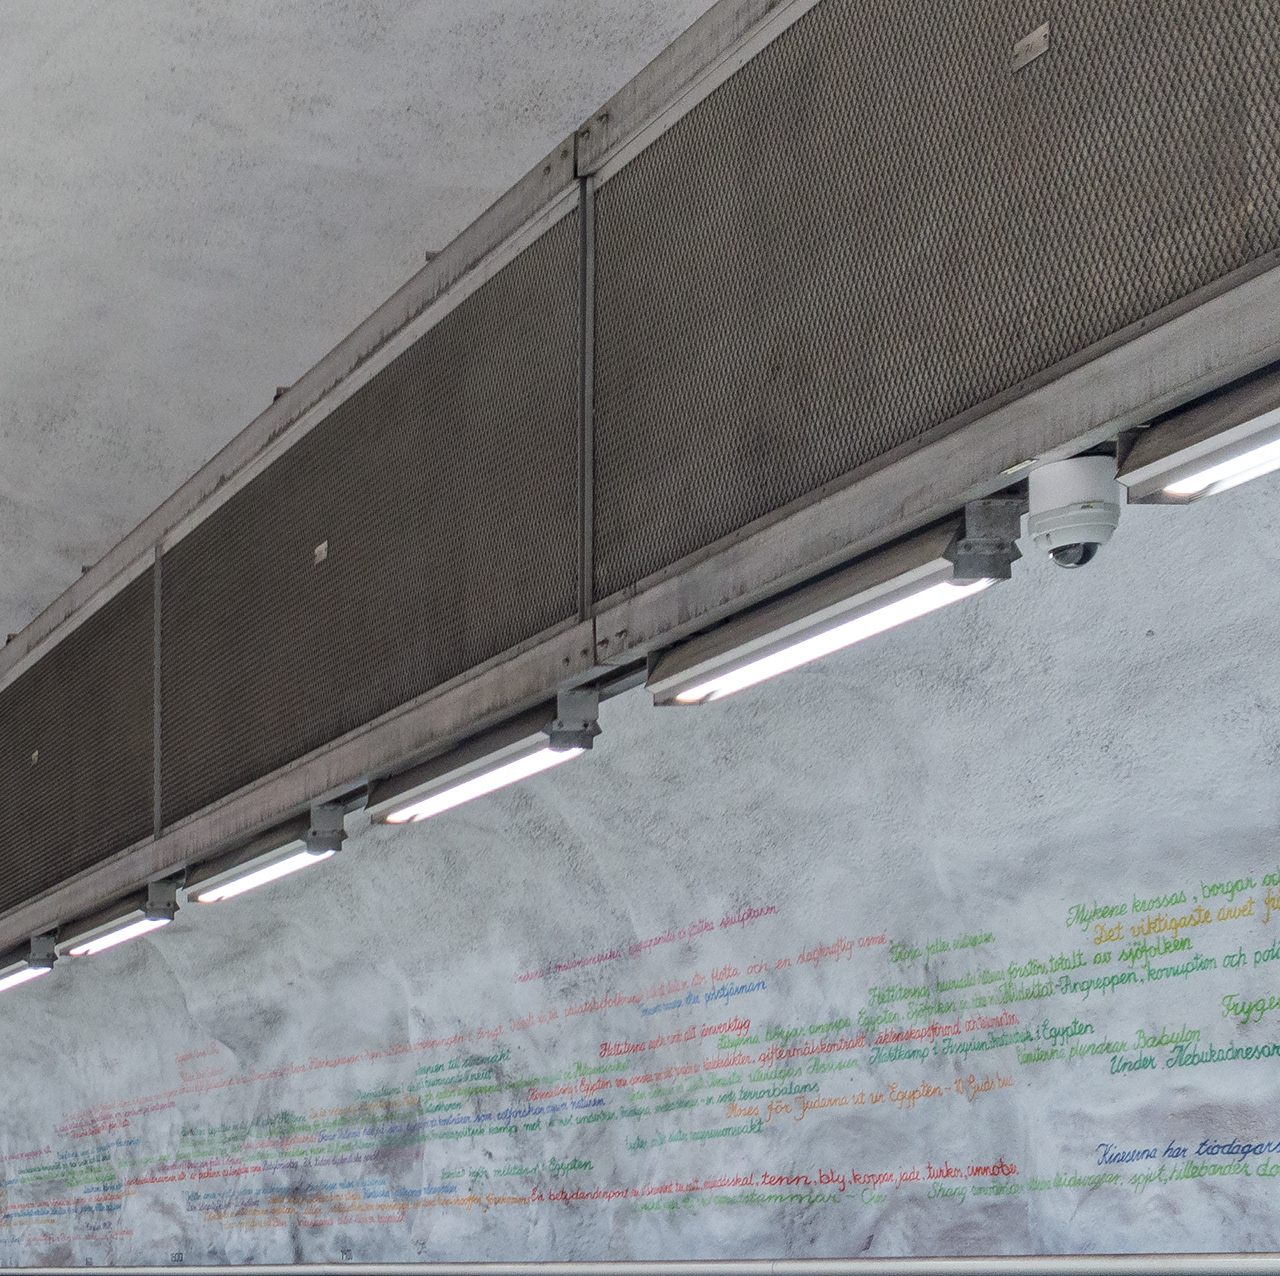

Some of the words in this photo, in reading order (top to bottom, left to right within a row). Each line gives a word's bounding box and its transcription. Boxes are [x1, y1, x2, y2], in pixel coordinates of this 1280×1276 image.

[1066, 900, 1128, 932] Mykene
[1200, 876, 1257, 902] borgar
[1094, 922, 1124, 945] Det
[1130, 905, 1212, 939] viktigaste
[1217, 897, 1255, 921] arvet
[775, 957, 791, 970] en
[858, 929, 887, 947] armé
[1093, 951, 1111, 965] av
[1118, 936, 1192, 969] sjöfolken
[1147, 953, 1217, 981] korruption
[1223, 946, 1247, 967] och
[1042, 1018, 1095, 1047] Egypten
[1134, 1024, 1201, 1051] Babylon
[1110, 1051, 1157, 1075] Under
[726, 1102, 759, 1119] Moses
[764, 1100, 791, 1122] för
[794, 1095, 848, 1121] Judarna
[852, 1093, 866, 1106] ut
[870, 1092, 885, 1104] ur
[888, 1081, 942, 1110] Egypten
[1096, 1142, 1157, 1165] Kineserna
[1162, 1139, 1188, 1159] har
[530, 1186, 545, 1202] En
